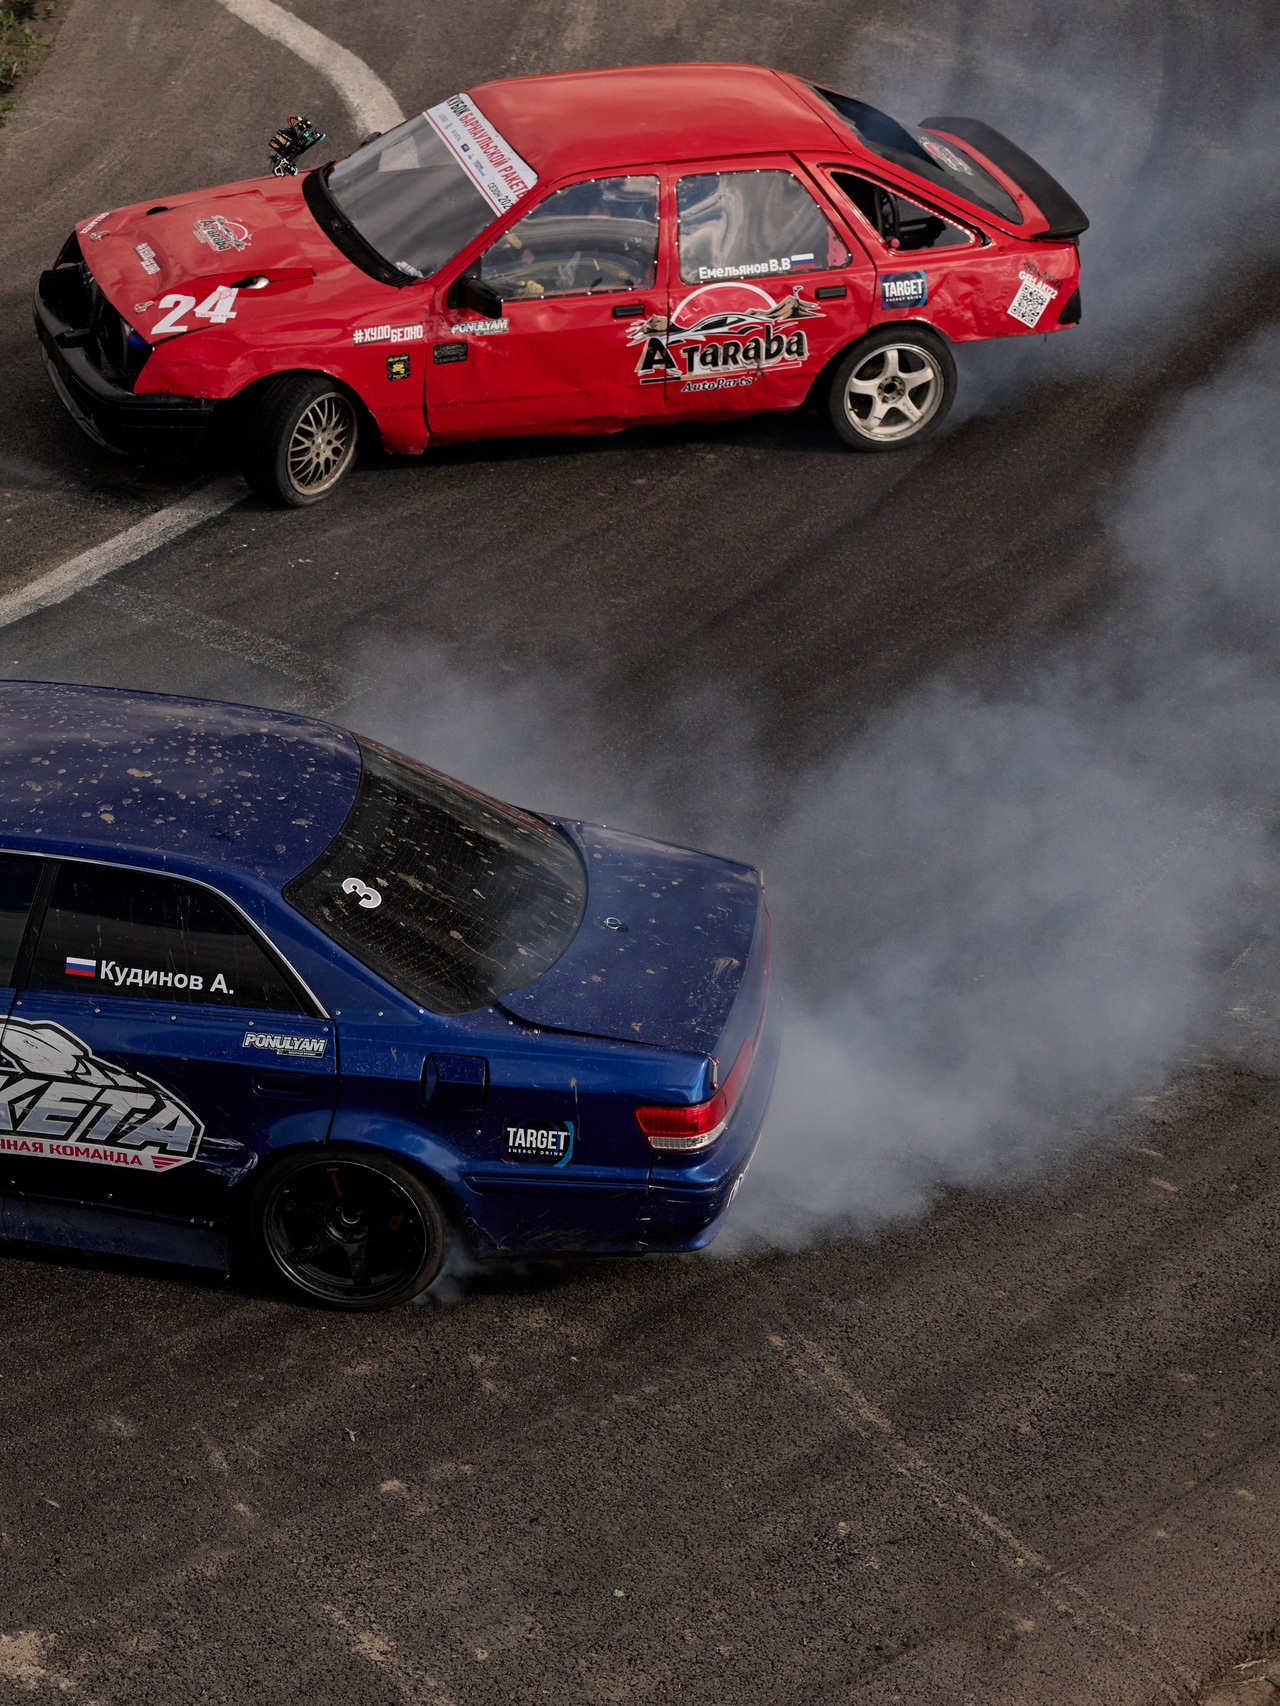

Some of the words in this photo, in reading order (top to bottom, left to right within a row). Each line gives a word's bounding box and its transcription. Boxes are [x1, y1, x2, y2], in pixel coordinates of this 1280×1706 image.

[458, 112, 512, 169] БАРНАУЛЬСКОЙ
[497, 195, 514, 210] 202
[698, 263, 769, 280] Емельянов
[882, 279, 924, 298] TARGET
[151, 285, 239, 335] 24
[450, 318, 509, 335] PONULYAM
[681, 376, 754, 393] AutoParts
[341, 877, 382, 909] 3
[99, 959, 204, 991] Кудинов
[209, 973, 235, 995] А.
[243, 1032, 327, 1053] PONULYAM
[506, 1127, 567, 1150] TARGET
[48, 1143, 144, 1166] КОМАНДА
[508, 1147, 537, 1155] ENERGY
